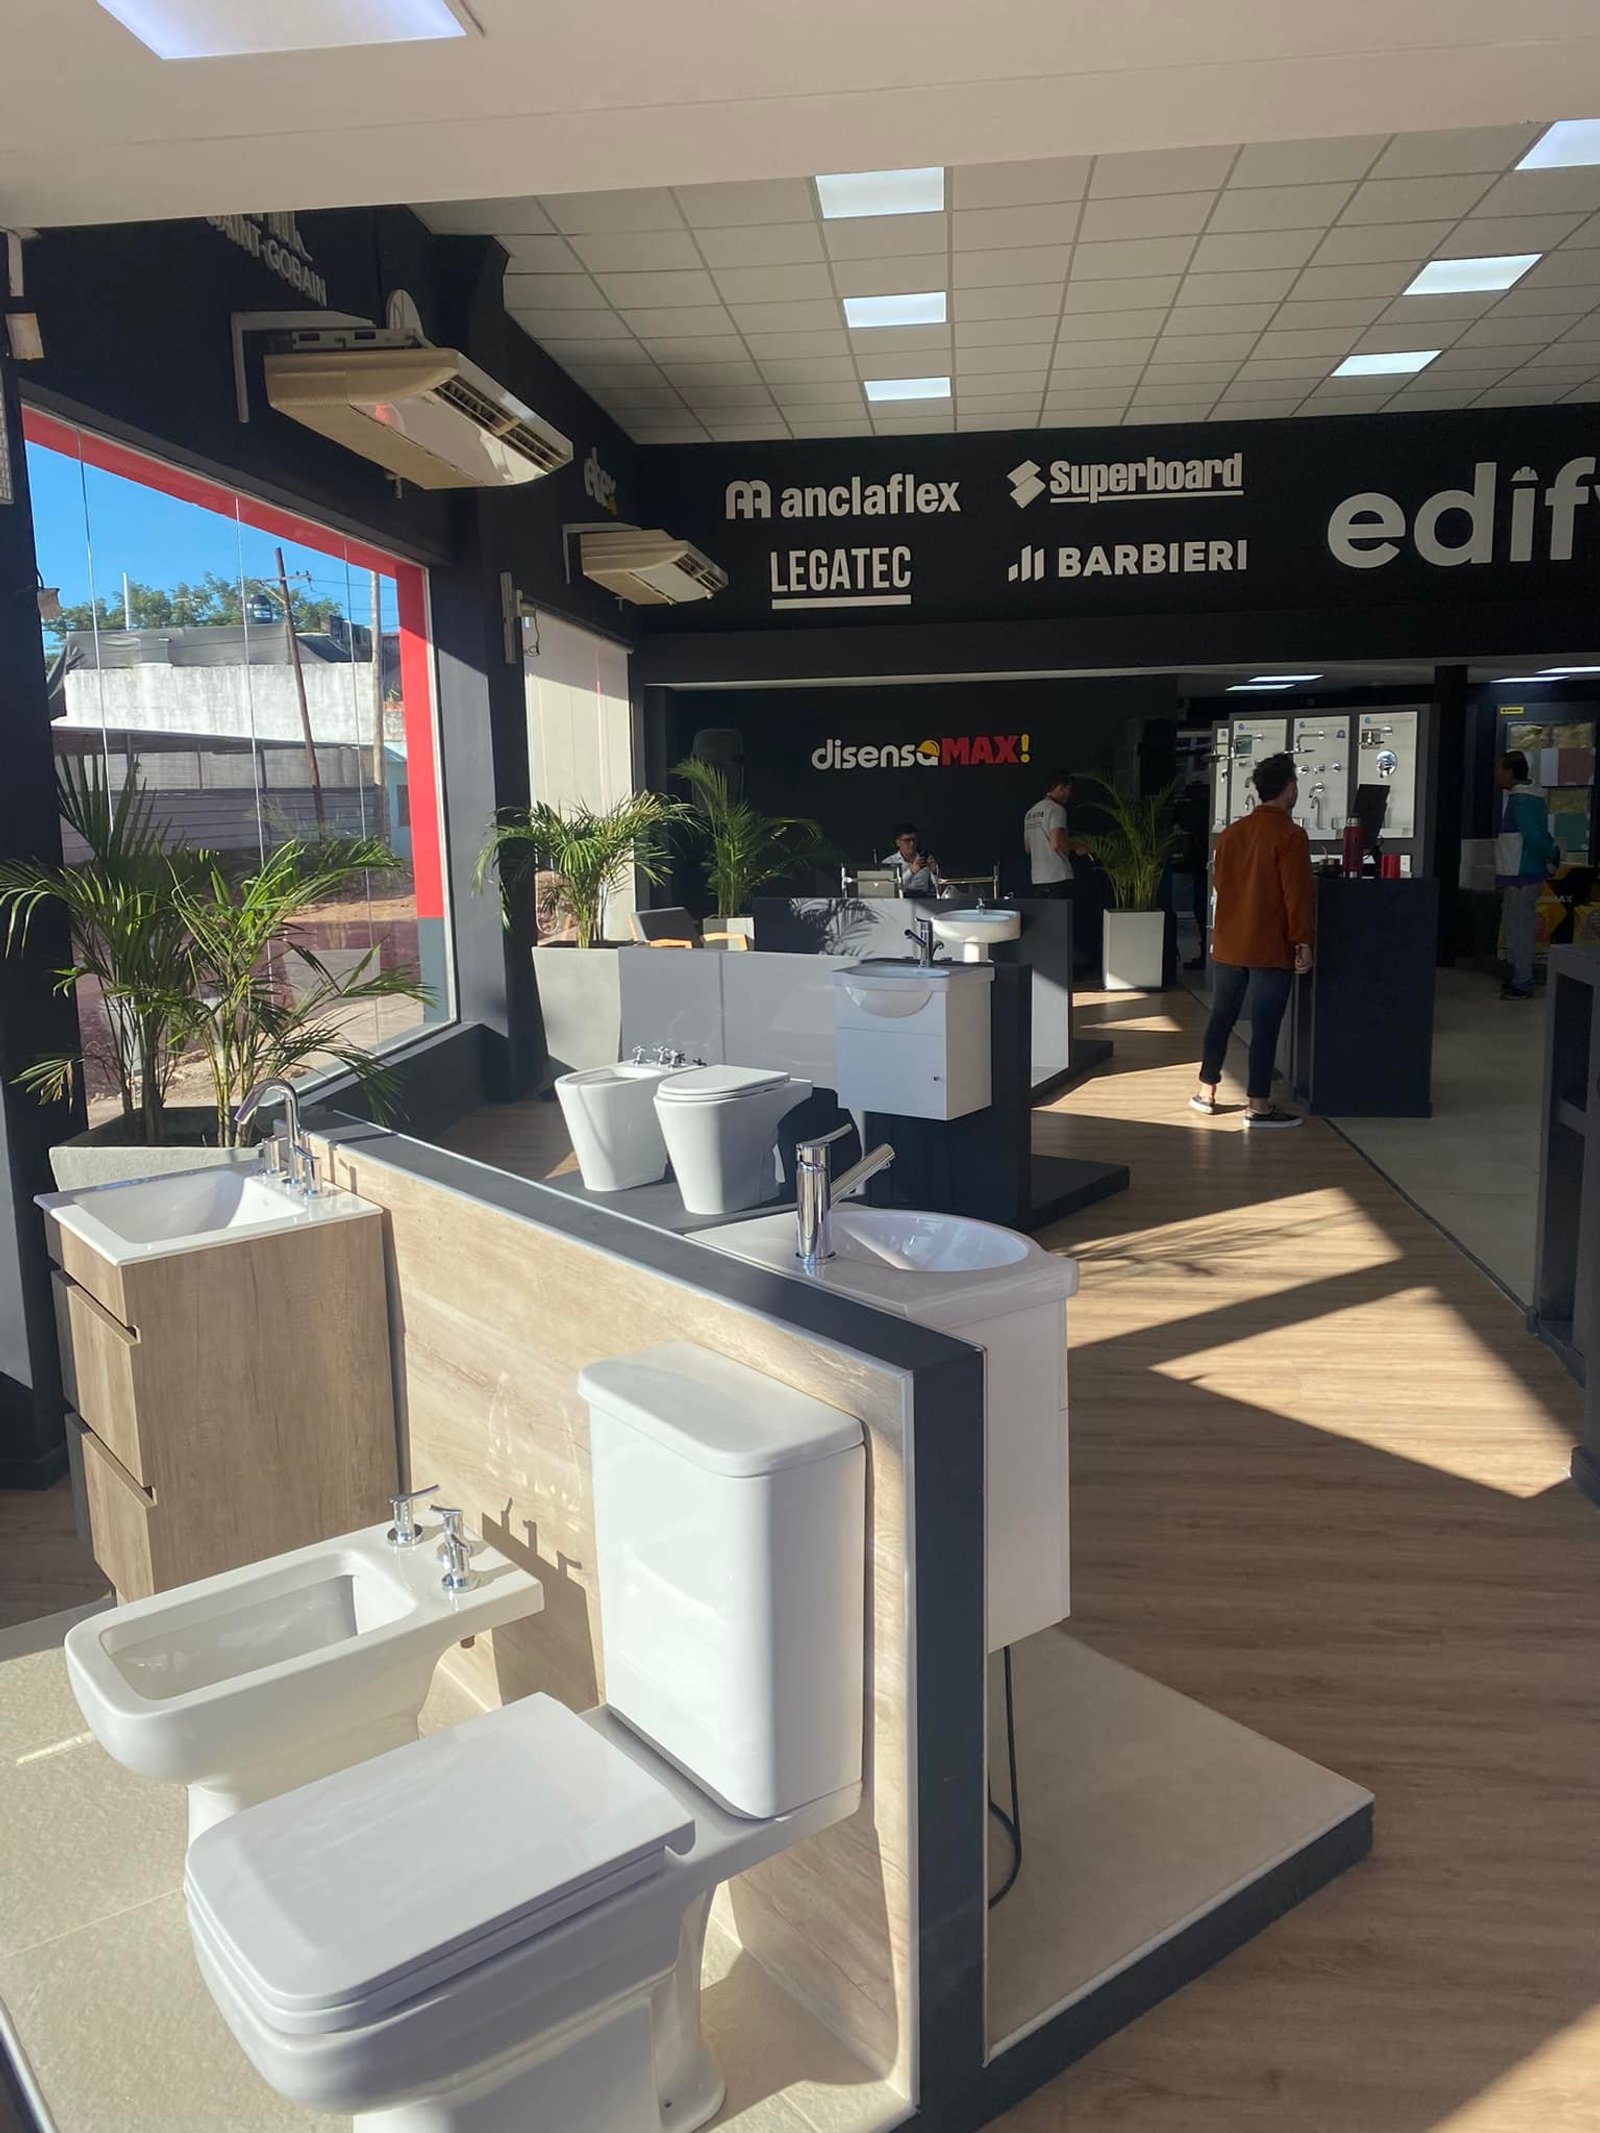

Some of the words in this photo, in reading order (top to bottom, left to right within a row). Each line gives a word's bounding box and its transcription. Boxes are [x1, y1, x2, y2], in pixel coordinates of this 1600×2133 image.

[780, 472, 961, 519] anclaflex
[1049, 452, 1244, 505] Superboard
[1327, 456, 1600, 570] edif
[770, 545, 912, 594] LEGATEC
[1058, 539, 1249, 579] BARBIERI
